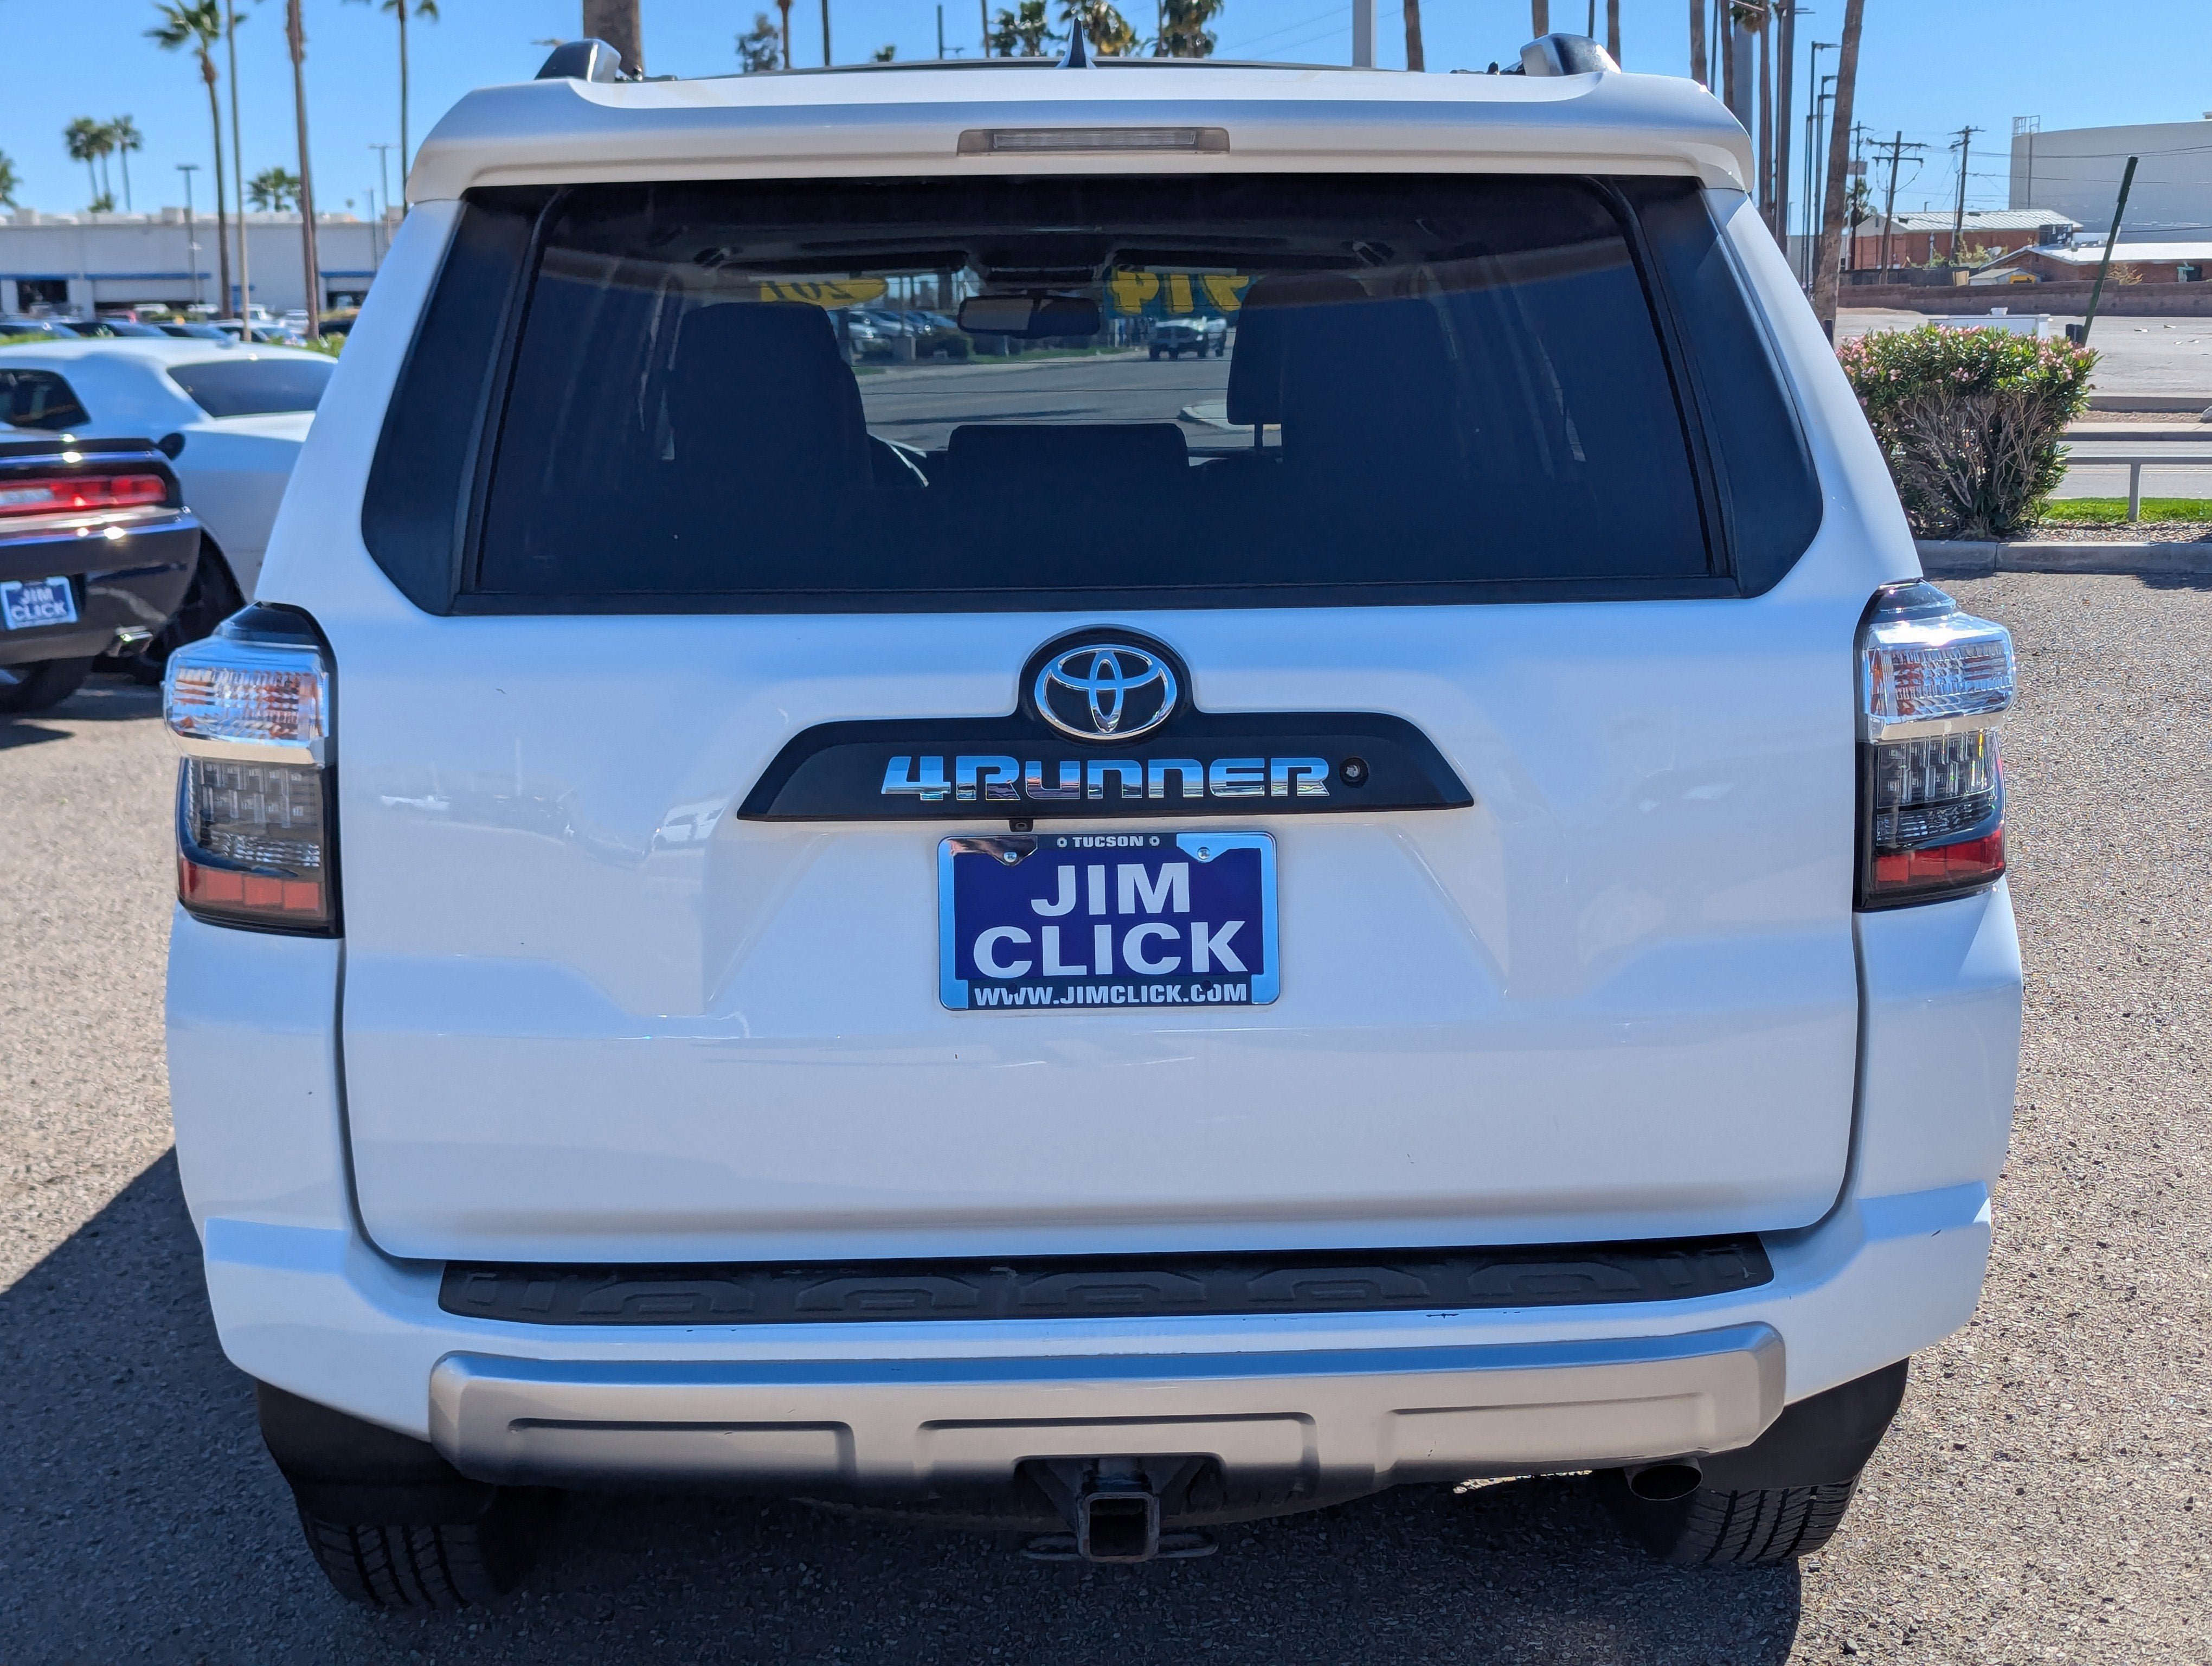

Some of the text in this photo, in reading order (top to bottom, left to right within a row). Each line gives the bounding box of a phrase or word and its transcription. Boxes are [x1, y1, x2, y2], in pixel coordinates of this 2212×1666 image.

[20, 587, 54, 605] JIM
[11, 600, 67, 620] CLICK
[1072, 836, 1143, 847] TUCSON
[1031, 862, 1190, 917] JIM
[973, 920, 1248, 978] CLICK
[974, 983, 1247, 1006] WWW.JIMCLICK.COM
